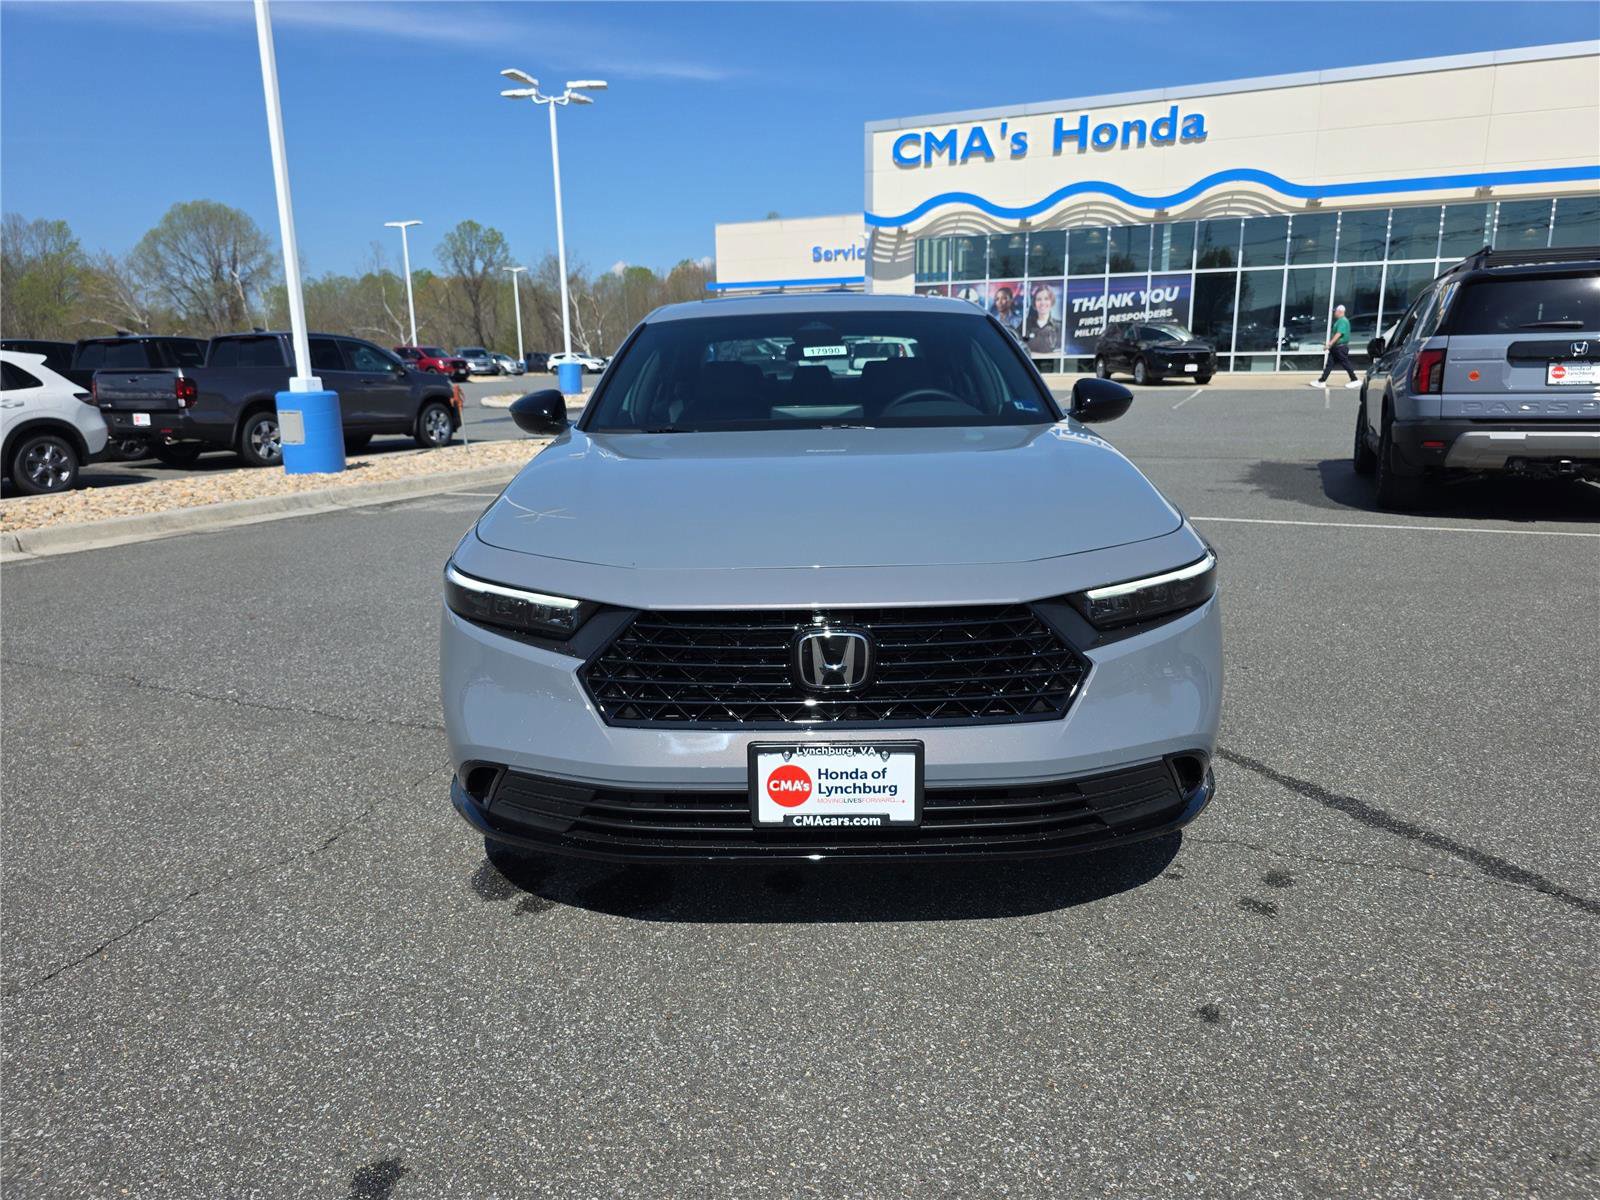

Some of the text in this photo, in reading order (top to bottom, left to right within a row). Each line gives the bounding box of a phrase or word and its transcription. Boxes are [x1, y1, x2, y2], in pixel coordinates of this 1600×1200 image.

[892, 105, 1208, 169] CMA's Honda
[812, 243, 866, 262] Servic
[1072, 286, 1180, 313] THANK YOU
[1079, 308, 1173, 326] FIRST RESPONDERS
[1074, 326, 1105, 338] MILIT
[796, 746, 876, 757] Lynchburg, VA
[818, 768, 887, 780] Honda of
[769, 780, 810, 792] CMA's
[818, 783, 898, 797] Lynchburg
[793, 815, 881, 827] CMAcars.com
